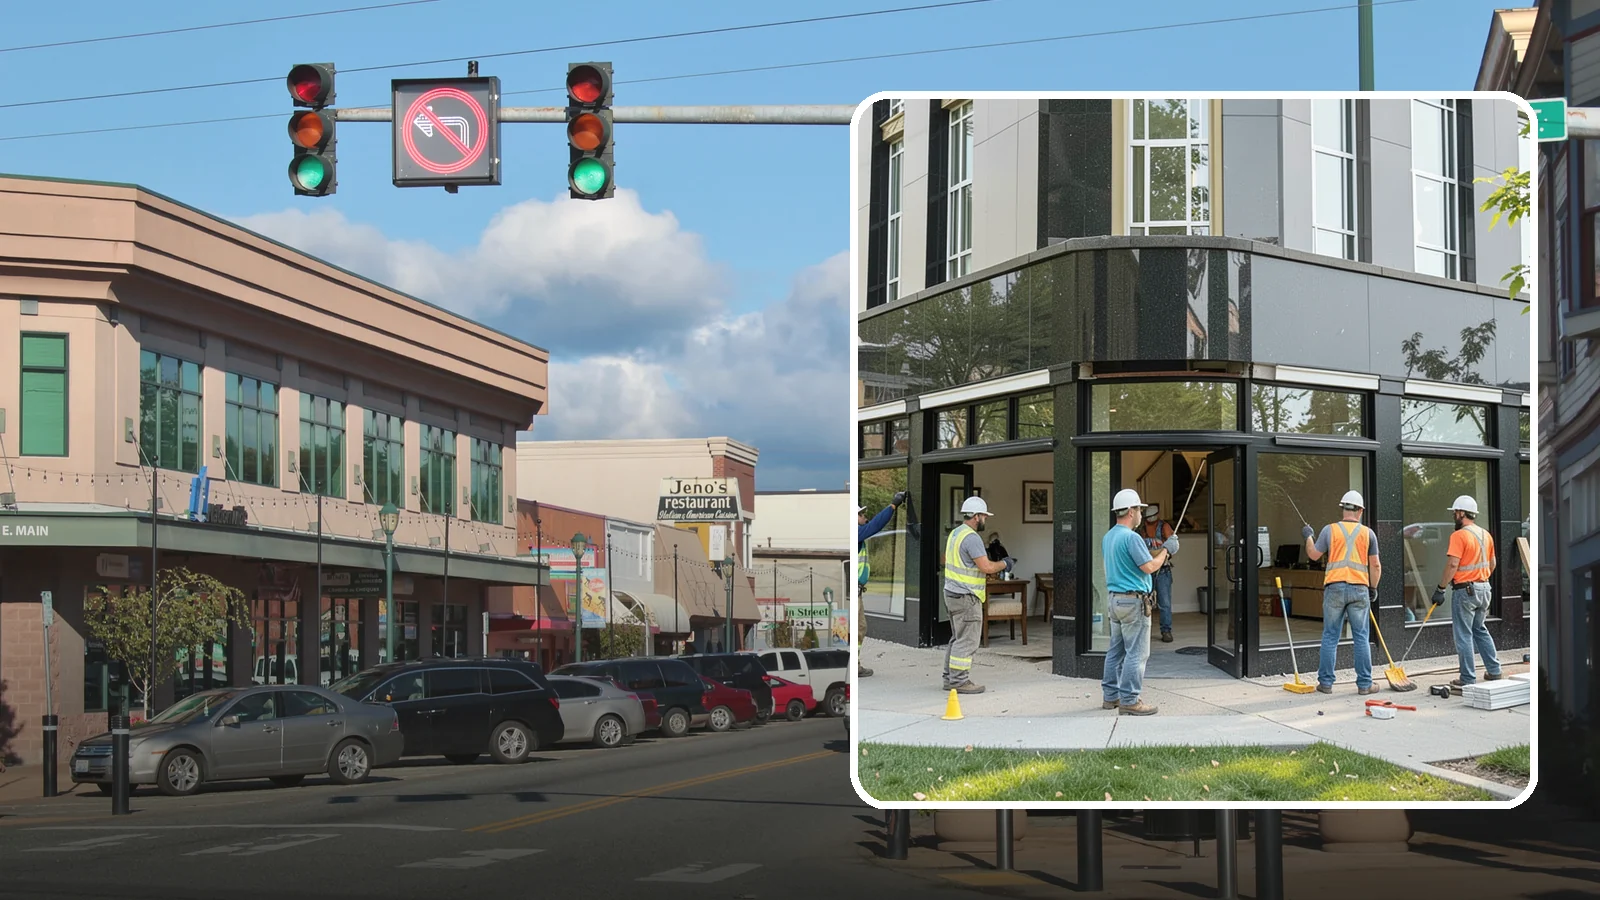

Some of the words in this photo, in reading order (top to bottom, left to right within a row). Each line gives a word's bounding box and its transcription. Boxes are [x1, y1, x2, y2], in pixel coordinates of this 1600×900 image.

[669, 480, 728, 494] Jeno's
[665, 496, 731, 509] restaurant
[658, 509, 682, 520] Italian
[686, 509, 715, 519] American
[715, 509, 738, 520] Cuisine
[2, 525, 13, 536] E.
[15, 525, 49, 536] MAIN
[797, 607, 828, 617] Street
